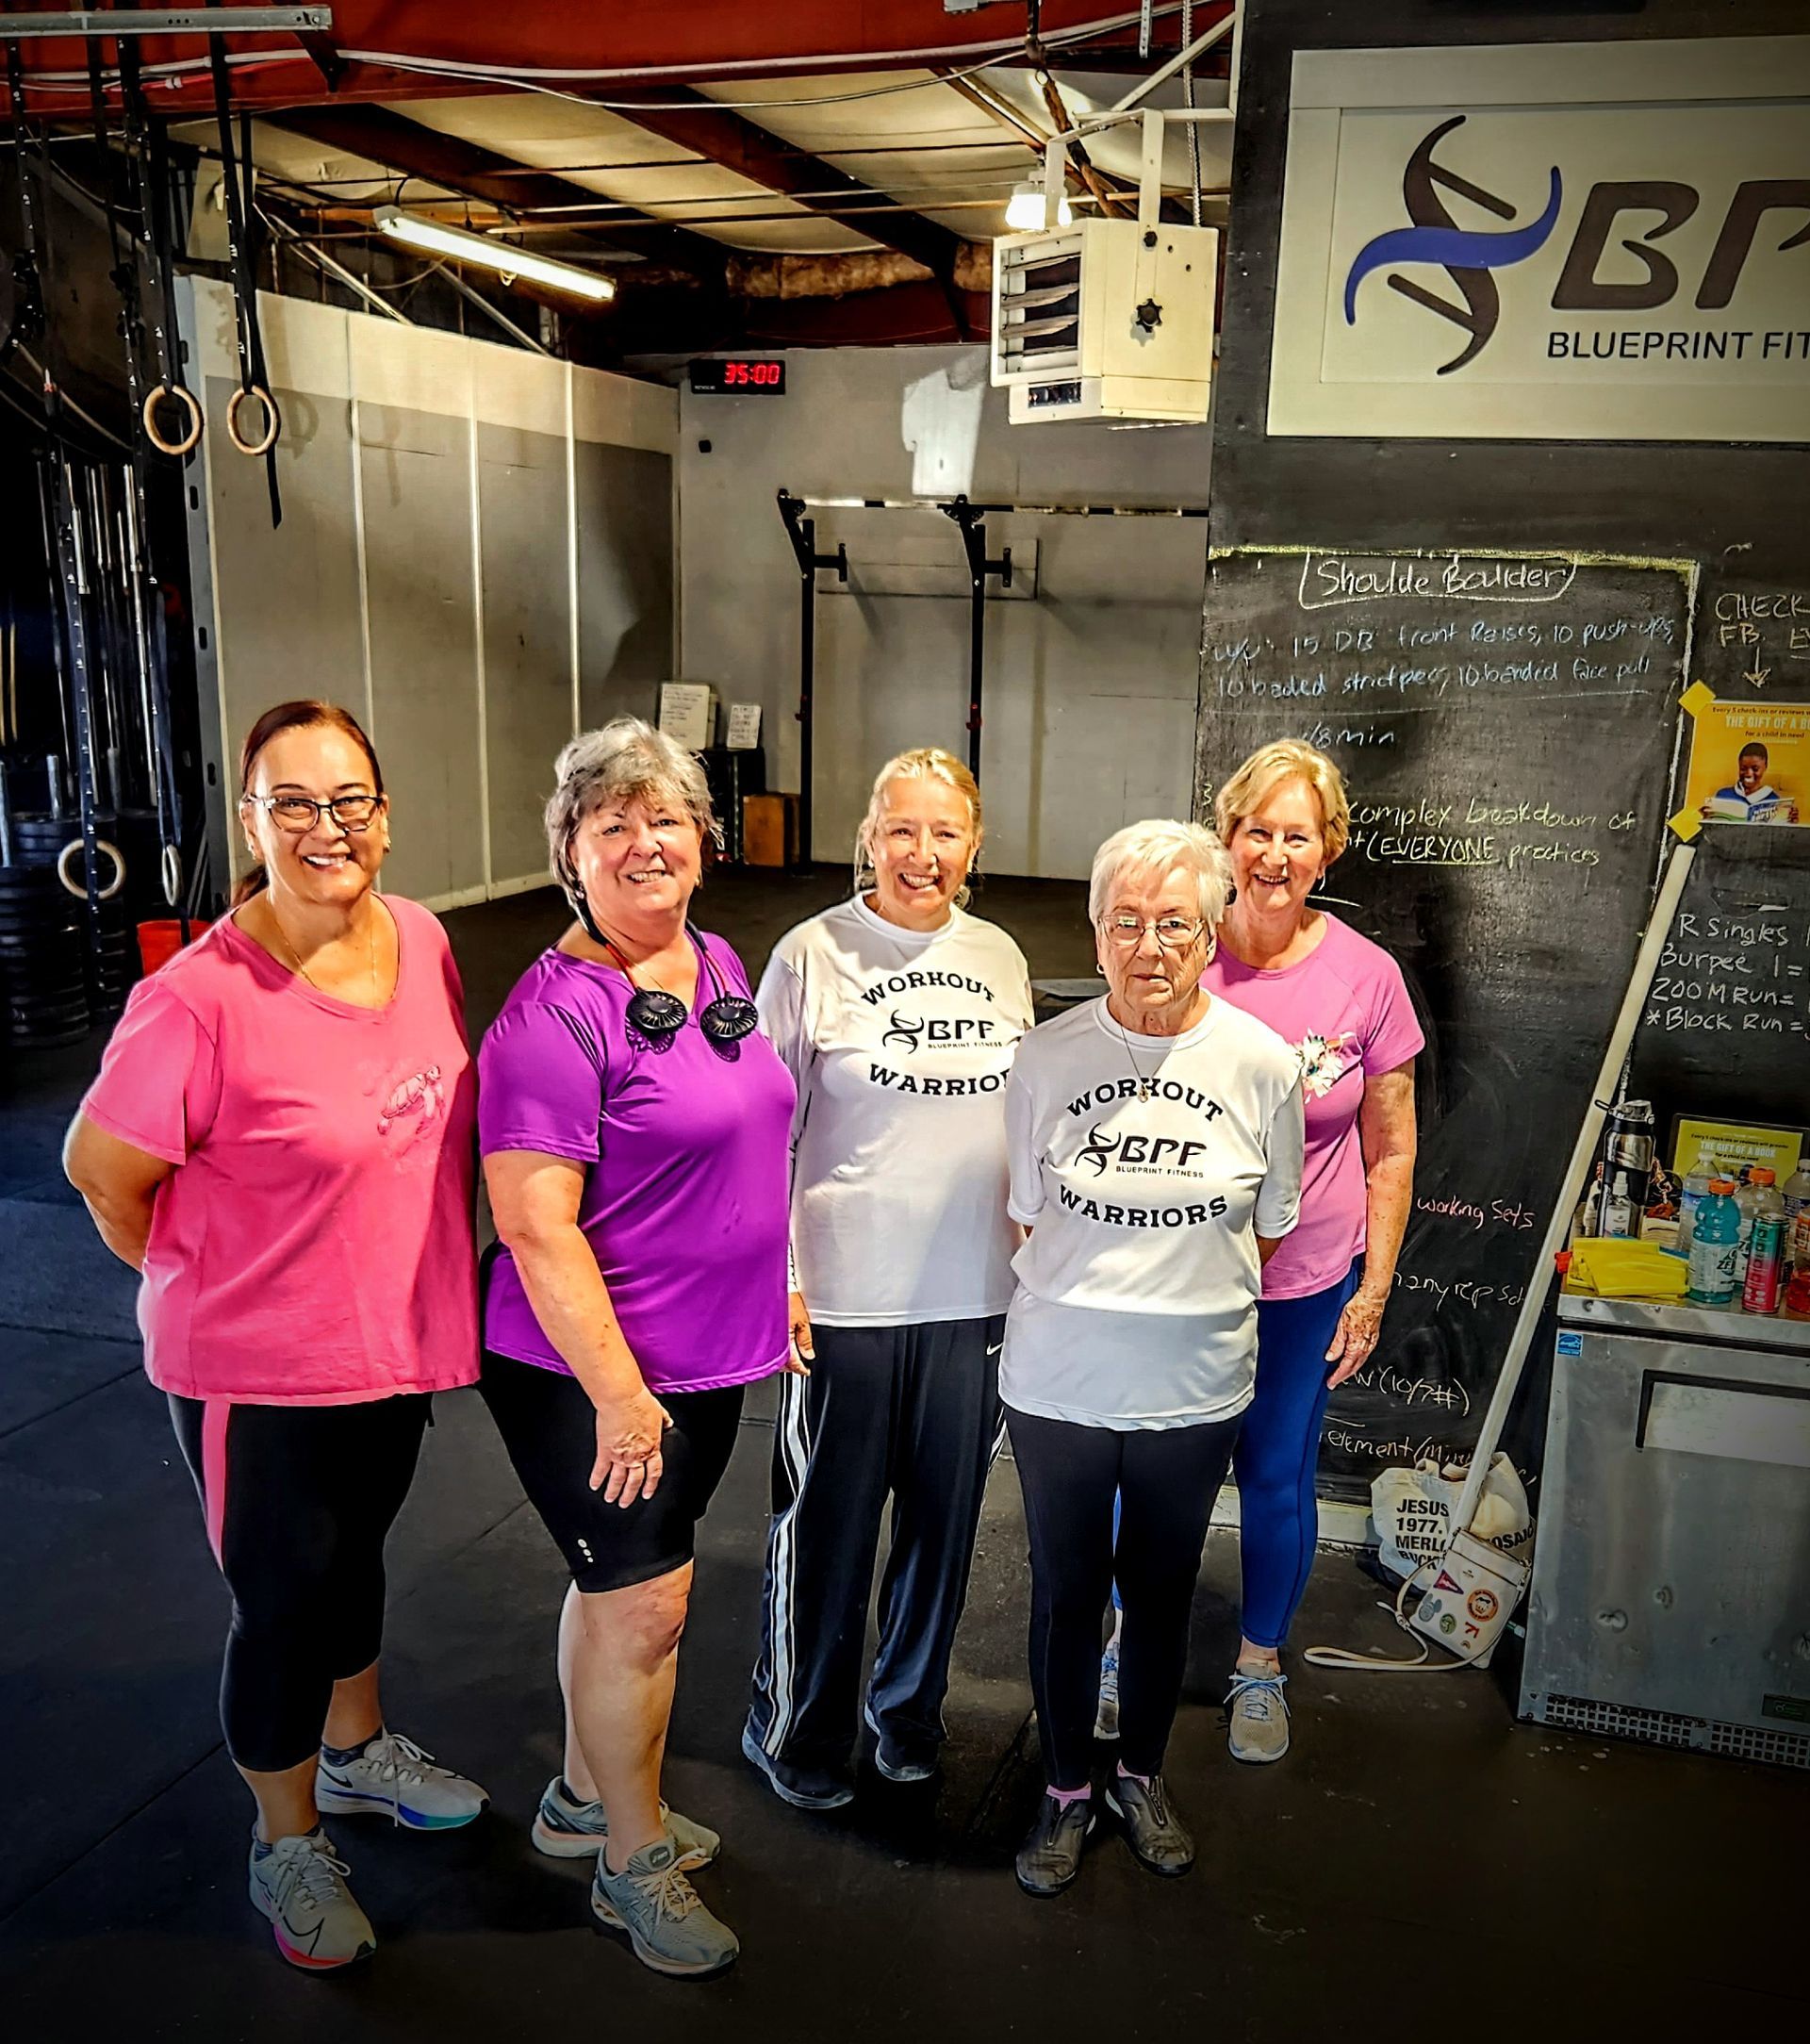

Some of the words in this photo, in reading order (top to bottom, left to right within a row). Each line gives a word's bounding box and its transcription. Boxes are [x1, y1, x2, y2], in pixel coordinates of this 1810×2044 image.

[1548, 331, 1752, 358] BLUEPRINT
[724, 363, 781, 385] 35:00
[1294, 636, 1319, 658] 15
[1555, 625, 1572, 643] 10
[1726, 716, 1744, 728] THE
[1748, 716, 1771, 728] GIFT
[1774, 717, 1787, 729] OF
[1789, 717, 1796, 729] A
[1707, 917, 1789, 946] Singles
[1660, 943, 1752, 976] Burpee
[861, 971, 995, 1006] WORKOUT
[928, 1020, 995, 1040] BPF
[1066, 1078, 1224, 1122] WORKOUT
[1118, 1135, 1208, 1166] BPF
[1701, 1141, 1715, 1150] THE
[1717, 1144, 1733, 1153] GIFT
[1736, 1146, 1745, 1154] OF
[1748, 1146, 1754, 1156] A
[1755, 1147, 1775, 1158] BOOK
[1116, 1165, 1162, 1175] BLUEPRINT
[1167, 1169, 1204, 1179] FITNESS
[1060, 1184, 1227, 1228] WARRIORS
[1396, 1499, 1449, 1517] JESUS
[1396, 1517, 1442, 1534] 1977.
